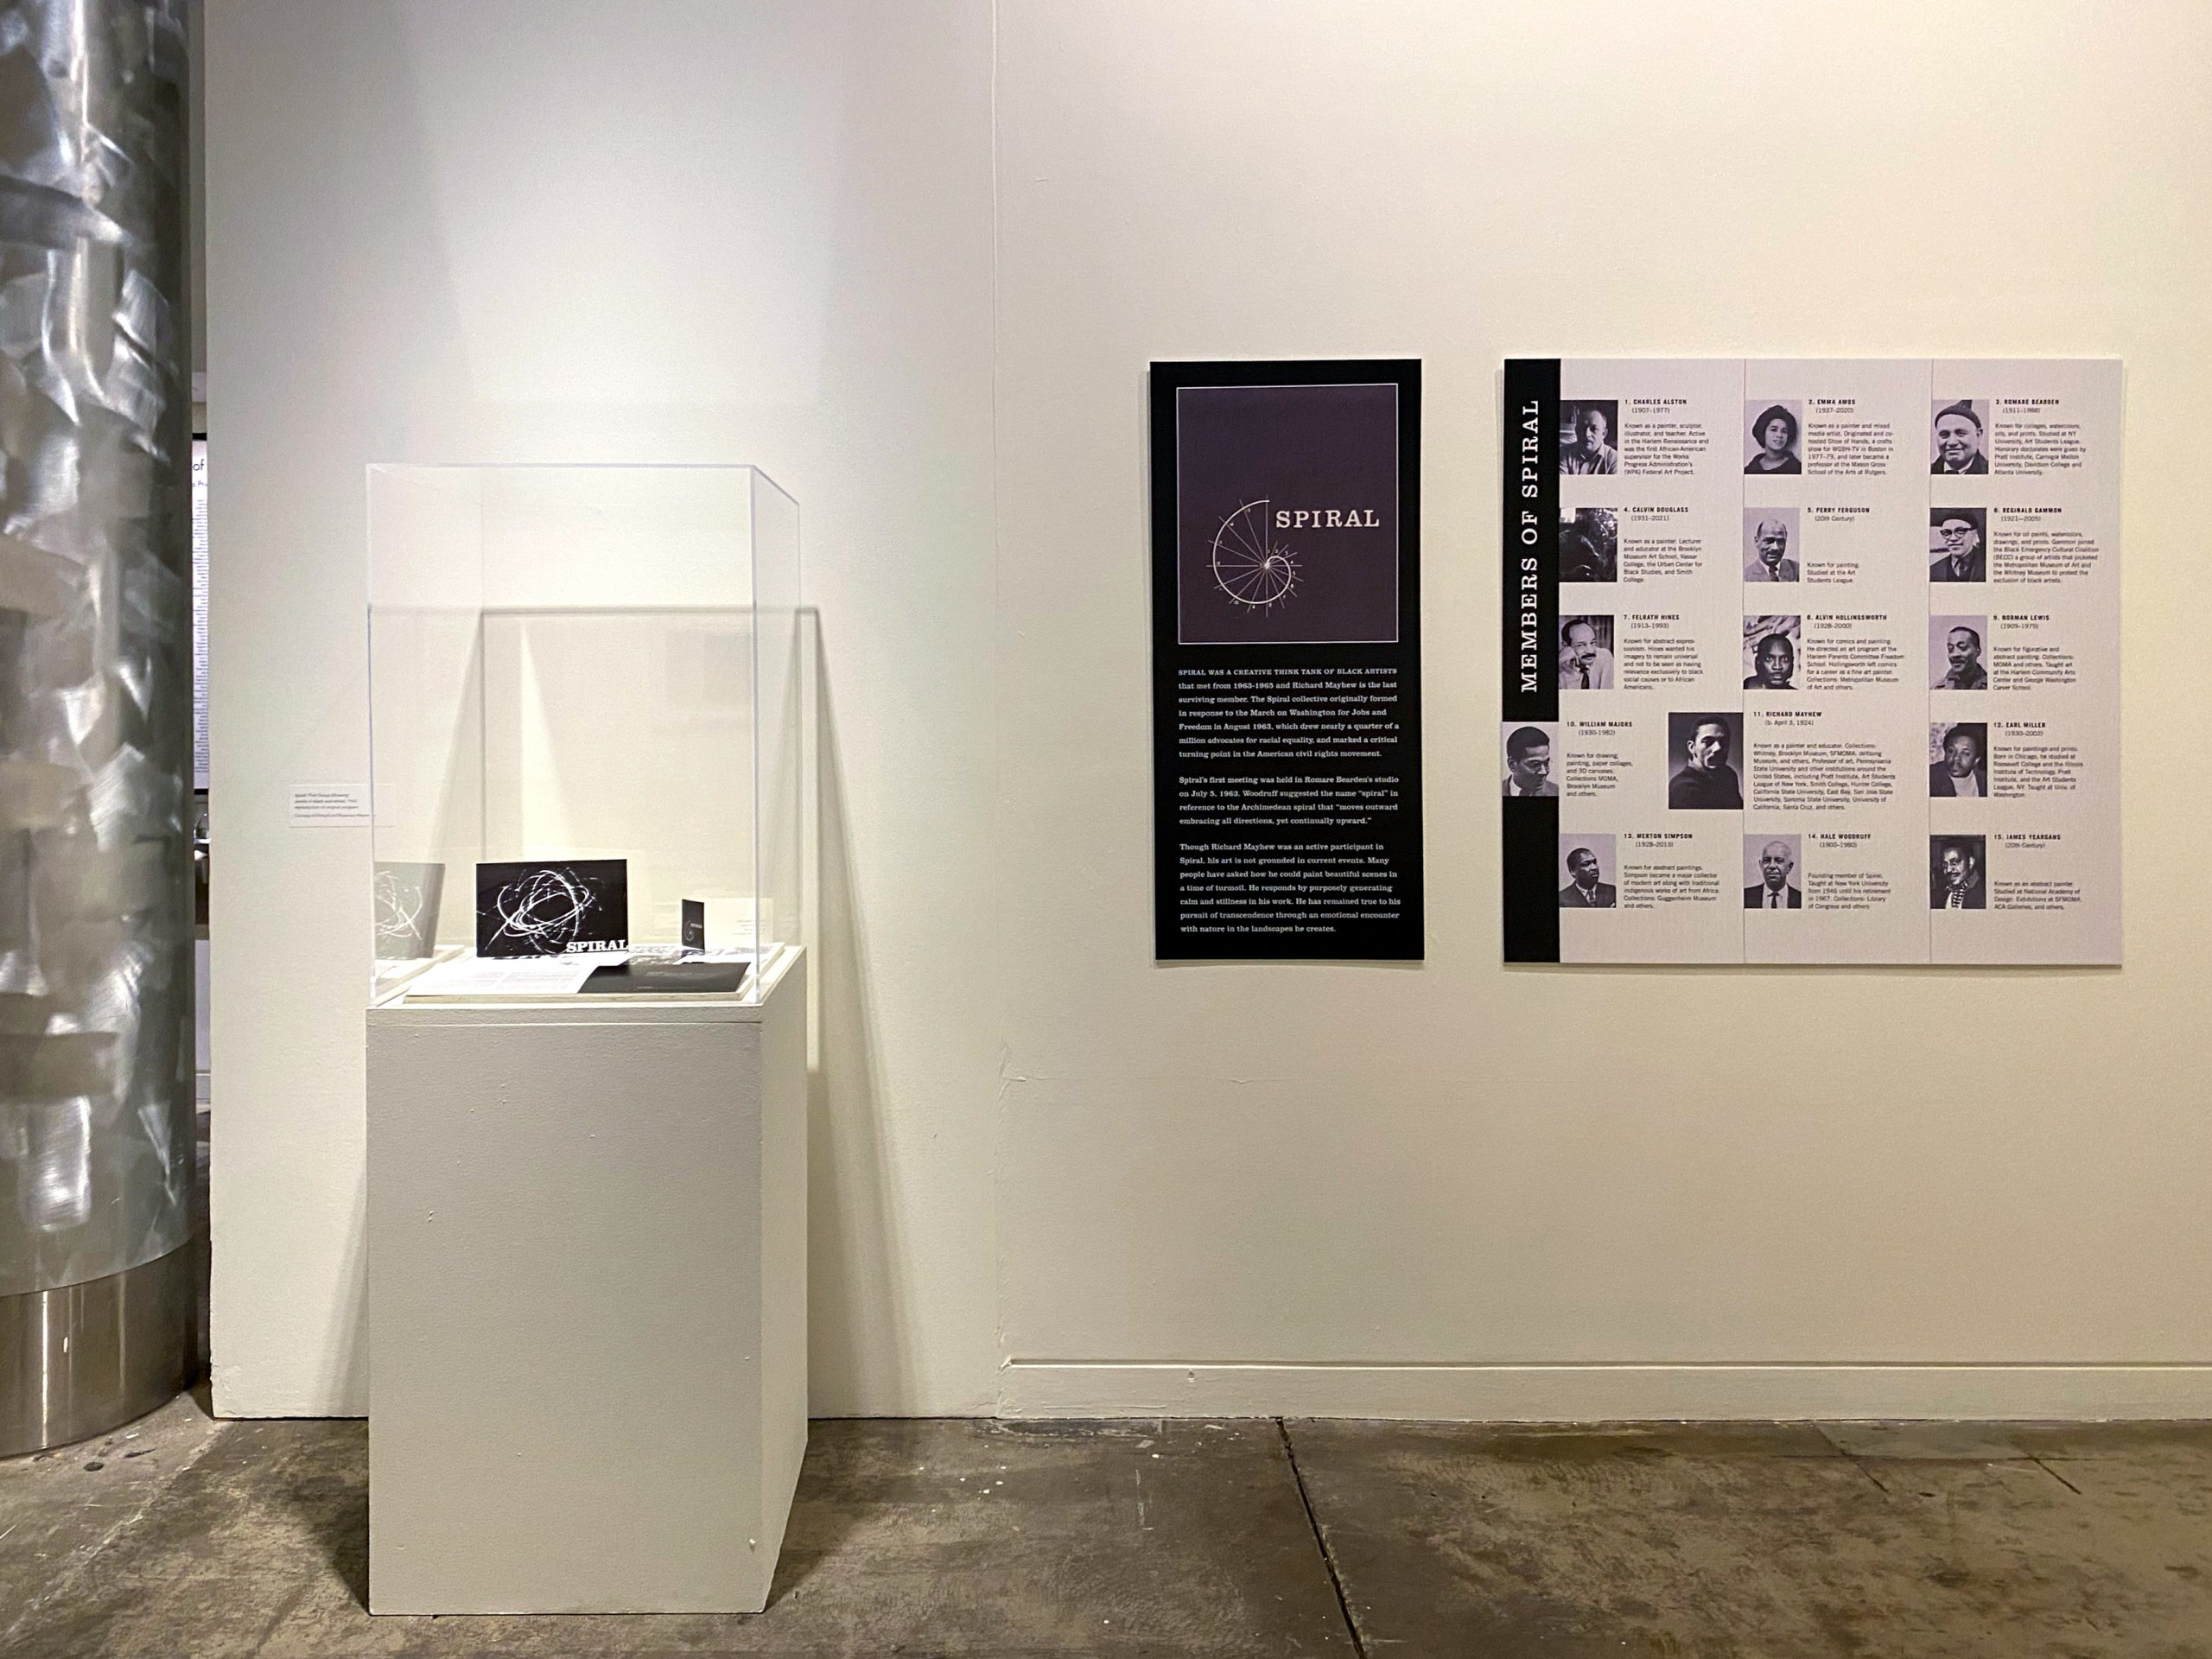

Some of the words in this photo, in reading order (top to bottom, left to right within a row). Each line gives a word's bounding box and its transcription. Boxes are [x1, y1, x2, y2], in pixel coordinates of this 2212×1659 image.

[1522, 400, 1538, 498] SPIRAL
[1275, 510, 1380, 528] SPIRAL
[1522, 511, 1538, 545] OF
[1522, 557, 1538, 693] MEMBERS
[1267, 696, 1290, 704] Spiral
[1329, 695, 1369, 703] originally
[1289, 709, 1336, 717] Washington
[1321, 722, 1345, 731] nearly
[1179, 817, 1221, 826] embracing
[566, 940, 629, 953] SPIRAL
